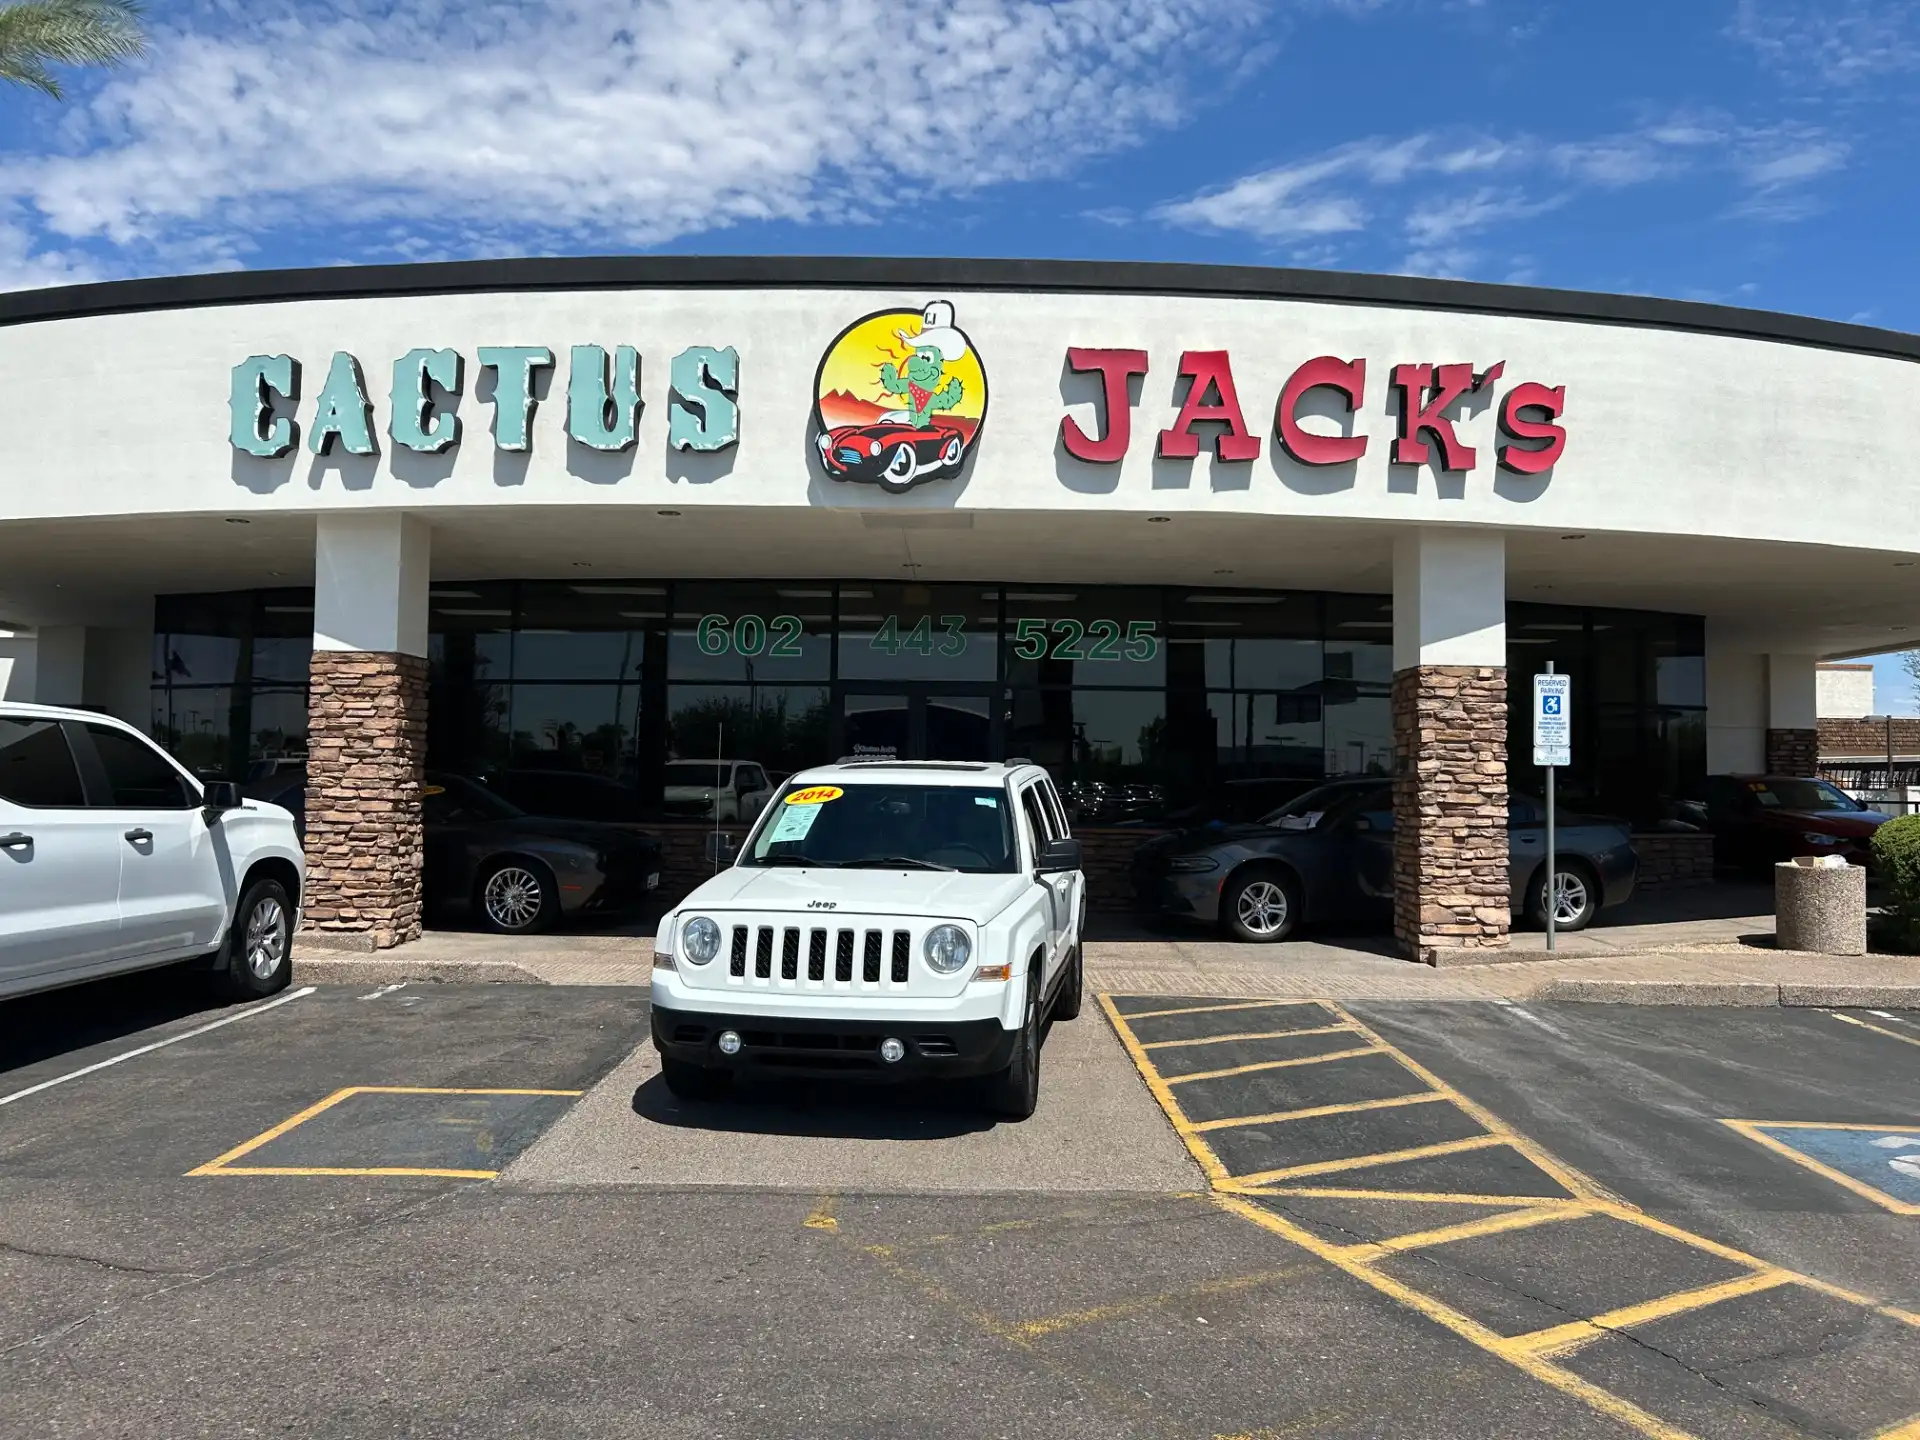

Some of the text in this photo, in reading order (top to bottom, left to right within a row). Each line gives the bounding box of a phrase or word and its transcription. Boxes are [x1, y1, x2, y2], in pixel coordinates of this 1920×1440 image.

[229, 344, 740, 459] CACTUS
[696, 614, 1159, 662] 602 443 5225
[1537, 679, 1567, 687] RESERVED
[1540, 687, 1564, 695] PARKING
[791, 789, 837, 802] 2014
[807, 900, 837, 910] Jeep
